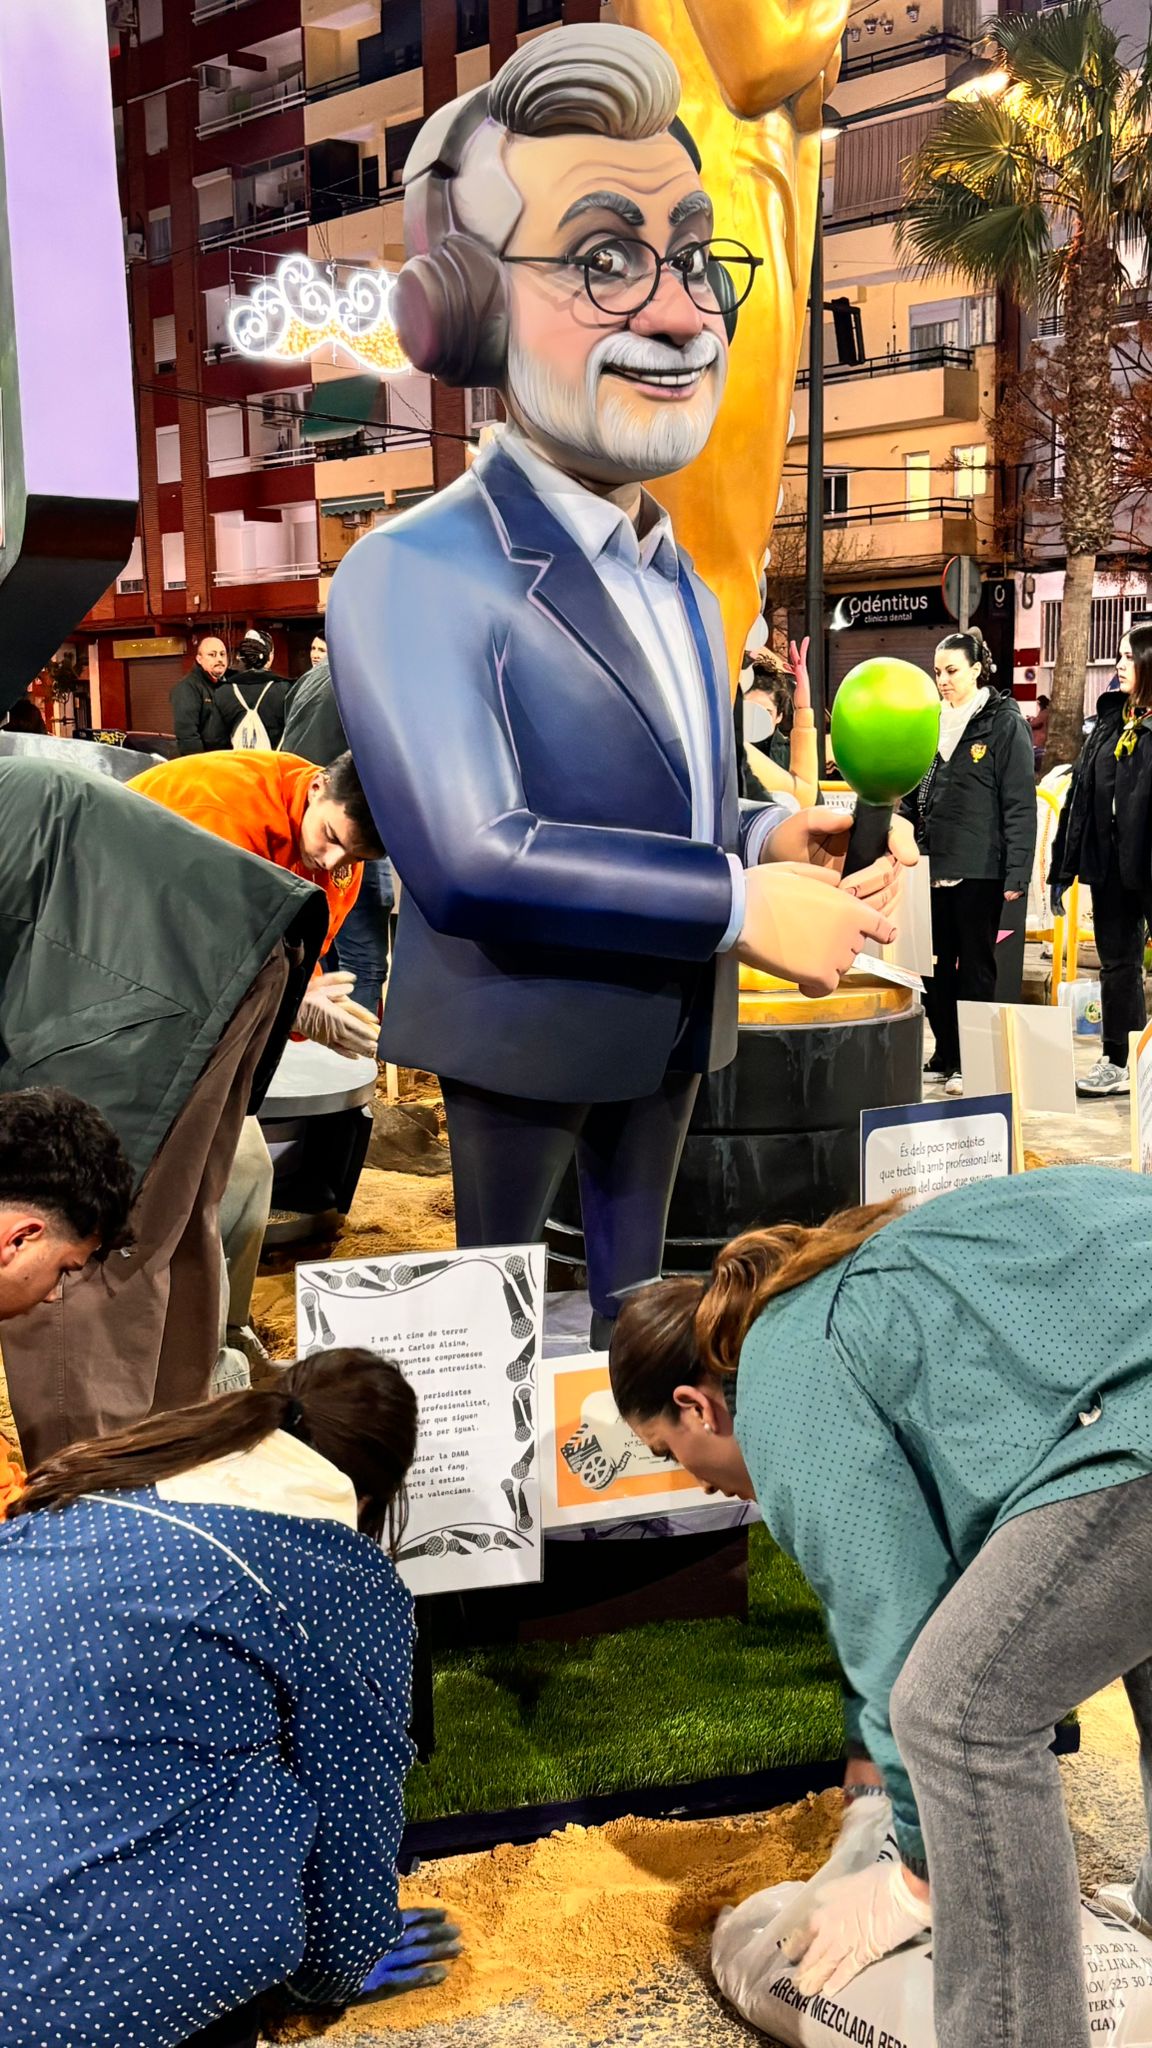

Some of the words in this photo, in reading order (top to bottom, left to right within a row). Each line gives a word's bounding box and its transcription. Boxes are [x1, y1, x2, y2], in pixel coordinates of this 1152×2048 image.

[850, 594, 928, 615] Odéntitus
[889, 612, 912, 621] dental
[900, 1143, 909, 1157] És
[910, 1141, 925, 1156] dels
[927, 1143, 944, 1157] pocs
[946, 1136, 985, 1154] periodistes
[880, 1169, 895, 1184] que
[897, 1161, 925, 1177] treballa
[927, 1158, 944, 1173] amb
[918, 1178, 930, 1194] del
[932, 1176, 952, 1191] color
[953, 1177, 968, 1188] que
[393, 1333, 402, 1341] el
[406, 1332, 424, 1340] cine
[428, 1330, 437, 1338] de
[441, 1327, 468, 1336] terror
[408, 1343, 435, 1353] Carlos
[439, 1340, 469, 1349] Alsina,
[400, 1356, 430, 1366] eguntes
[417, 1367, 435, 1376] cada
[439, 1363, 486, 1374] entrevista.
[423, 1389, 471, 1401] periodistes
[434, 1416, 448, 1424] que
[452, 1413, 478, 1422] siguen
[419, 1430, 432, 1438] ots
[436, 1427, 450, 1437] per
[454, 1424, 479, 1434] igual.
[439, 1452, 447, 1460] la
[451, 1450, 469, 1458] DANA
[430, 1464, 443, 1473] del
[448, 1463, 468, 1472] fang,
[438, 1476, 465, 1484] estima
[428, 1487, 475, 1498] valencians.
[1094, 1943, 1109, 1955] 30
[1109, 1942, 1124, 1953] 20
[1087, 1960, 1106, 1973] DE
[1131, 1975, 1145, 1988] 30
[769, 1976, 811, 2014] ARENA
[811, 1995, 875, 2048] MEZCLADA
[1088, 1998, 1125, 2013] TERNA
